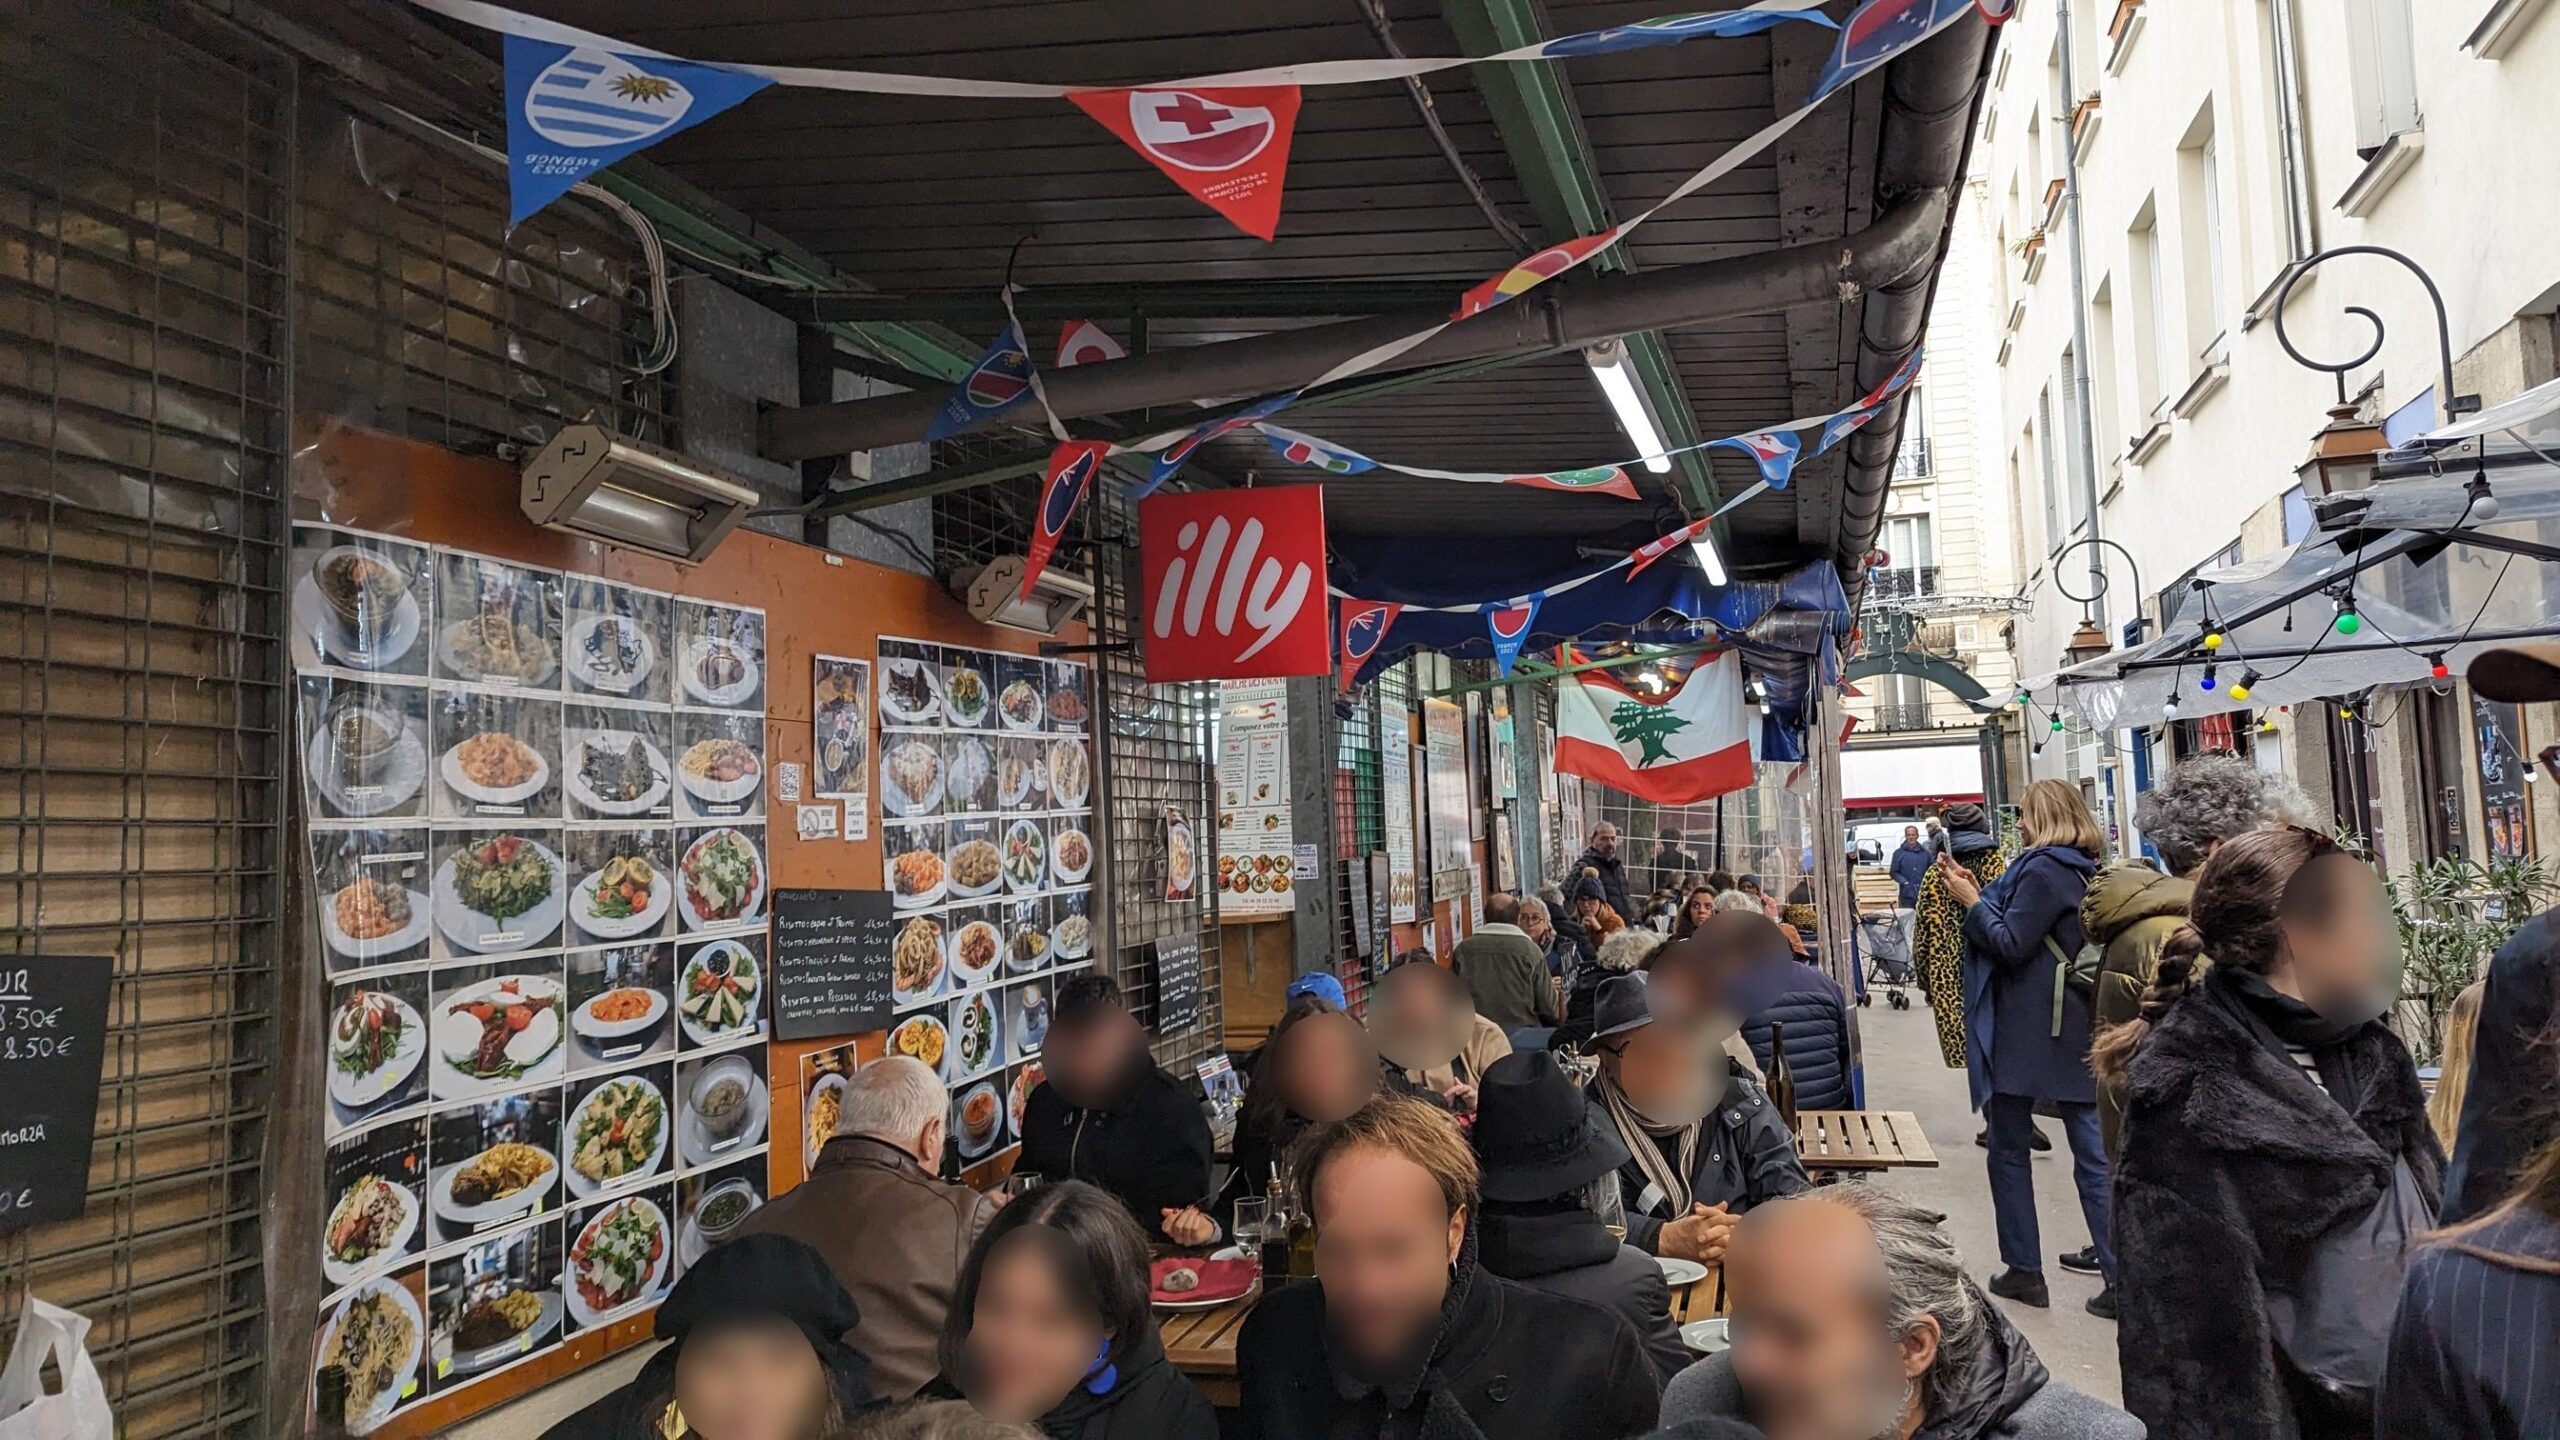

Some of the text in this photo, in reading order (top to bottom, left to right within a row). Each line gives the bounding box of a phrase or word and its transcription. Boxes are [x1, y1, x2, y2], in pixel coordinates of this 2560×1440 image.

[1153, 514, 1312, 664] illy
[1229, 723, 1261, 733] Composez
[1263, 721, 1280, 729] votre
